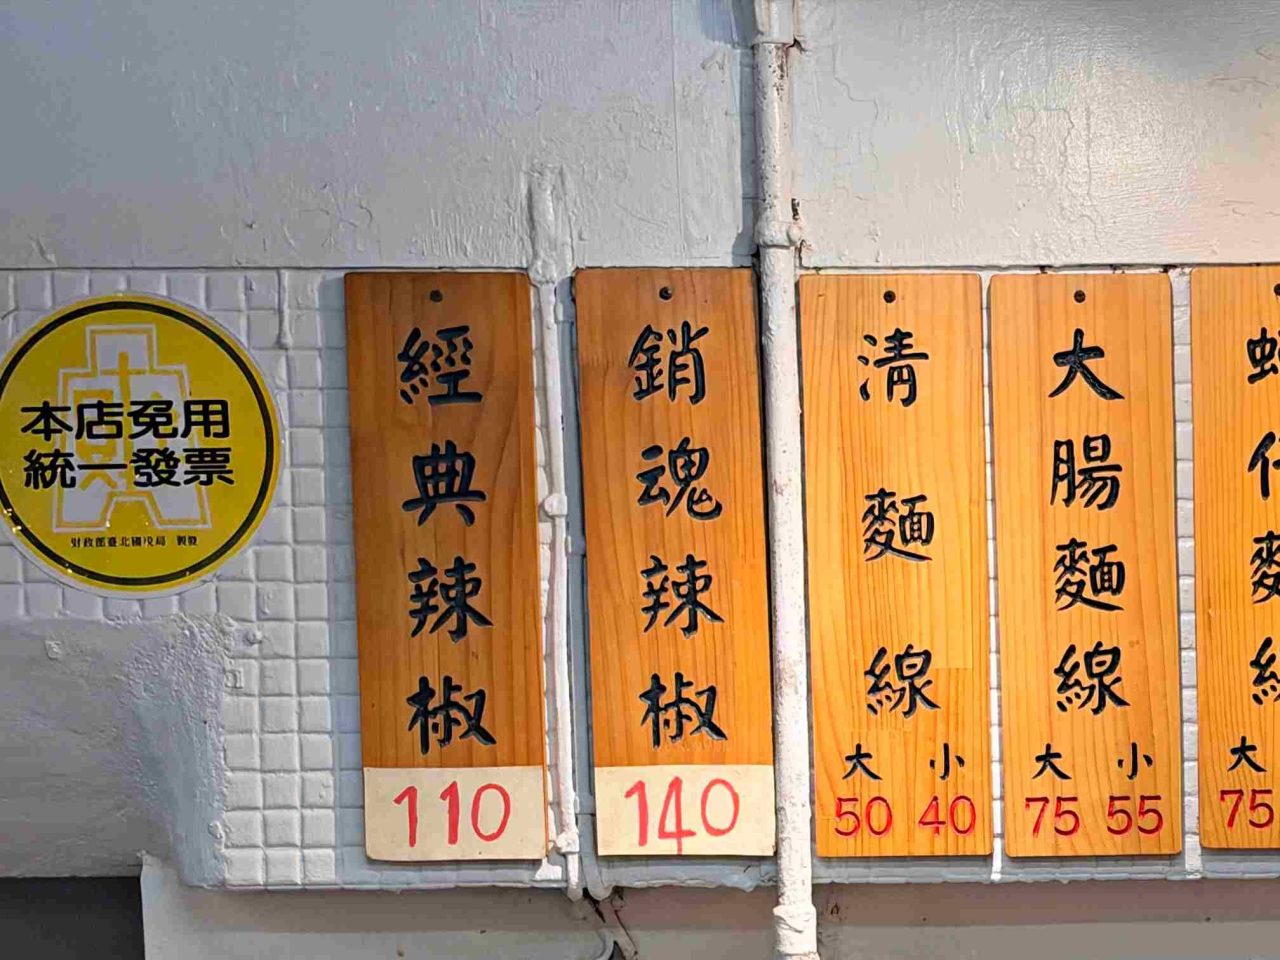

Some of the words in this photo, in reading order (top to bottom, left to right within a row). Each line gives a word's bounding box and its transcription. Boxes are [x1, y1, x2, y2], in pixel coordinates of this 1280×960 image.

[20, 399, 230, 442] 本店免用
[23, 447, 235, 490] 統一發票
[396, 324, 497, 756] 經典辣椒
[627, 320, 729, 752] 銷魂辣椒
[857, 327, 940, 719] 清麵線
[1049, 327, 1131, 717] 大腸麵線
[844, 743, 882, 781] 大
[929, 742, 965, 780] 小
[1034, 743, 1072, 781] 大
[1117, 741, 1153, 780] 小
[1226, 735, 1268, 773] 大
[393, 780, 511, 848] 110
[624, 777, 740, 856] 140
[833, 796, 894, 837] 50
[918, 795, 977, 837] 40
[1024, 796, 1080, 837] 75
[1106, 795, 1164, 836] 55
[1219, 788, 1275, 829] 75
